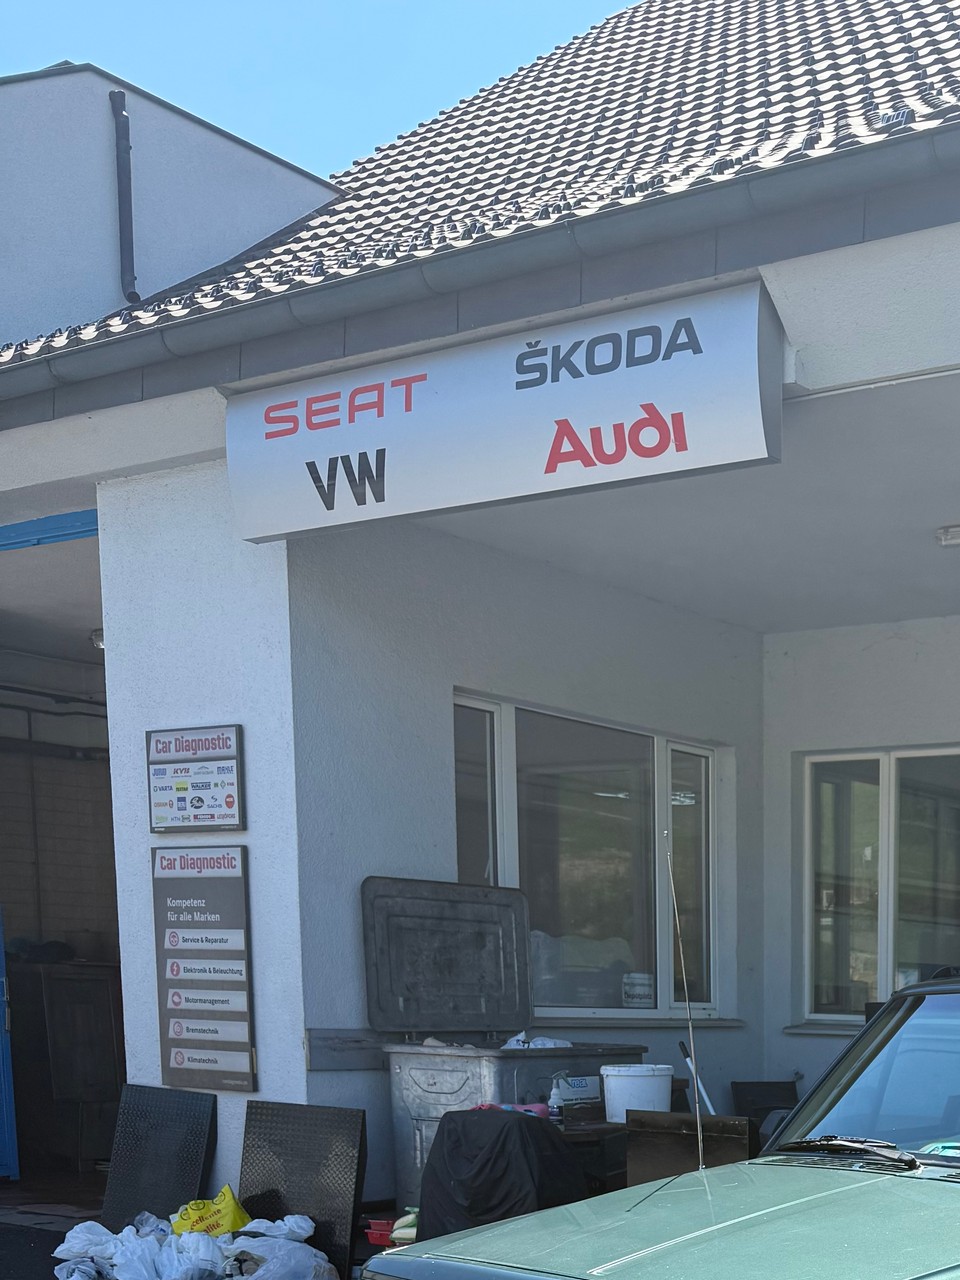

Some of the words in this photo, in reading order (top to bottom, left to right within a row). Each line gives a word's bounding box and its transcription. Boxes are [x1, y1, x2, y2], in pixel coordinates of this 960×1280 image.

[515, 317, 703, 390] ŠKODA
[264, 373, 428, 440] SEAT
[544, 402, 689, 474] Audi
[306, 448, 386, 511] VW
[155, 739, 172, 754] Car
[174, 733, 232, 755] Diagnostic
[160, 855, 177, 870] Car
[179, 853, 237, 873] Diagnostic
[166, 897, 206, 909] Kompetenz
[167, 911, 178, 922] für
[179, 912, 192, 922] alle
[193, 912, 221, 922] Marken
[204, 937, 229, 945] Reparatur
[183, 966, 208, 974] Elektronik
[212, 967, 243, 977] Beleuchtung
[184, 996, 230, 1006] Motormanagement
[185, 1026, 219, 1035] Bremstechnik
[187, 1056, 218, 1064] Klimatechnik
